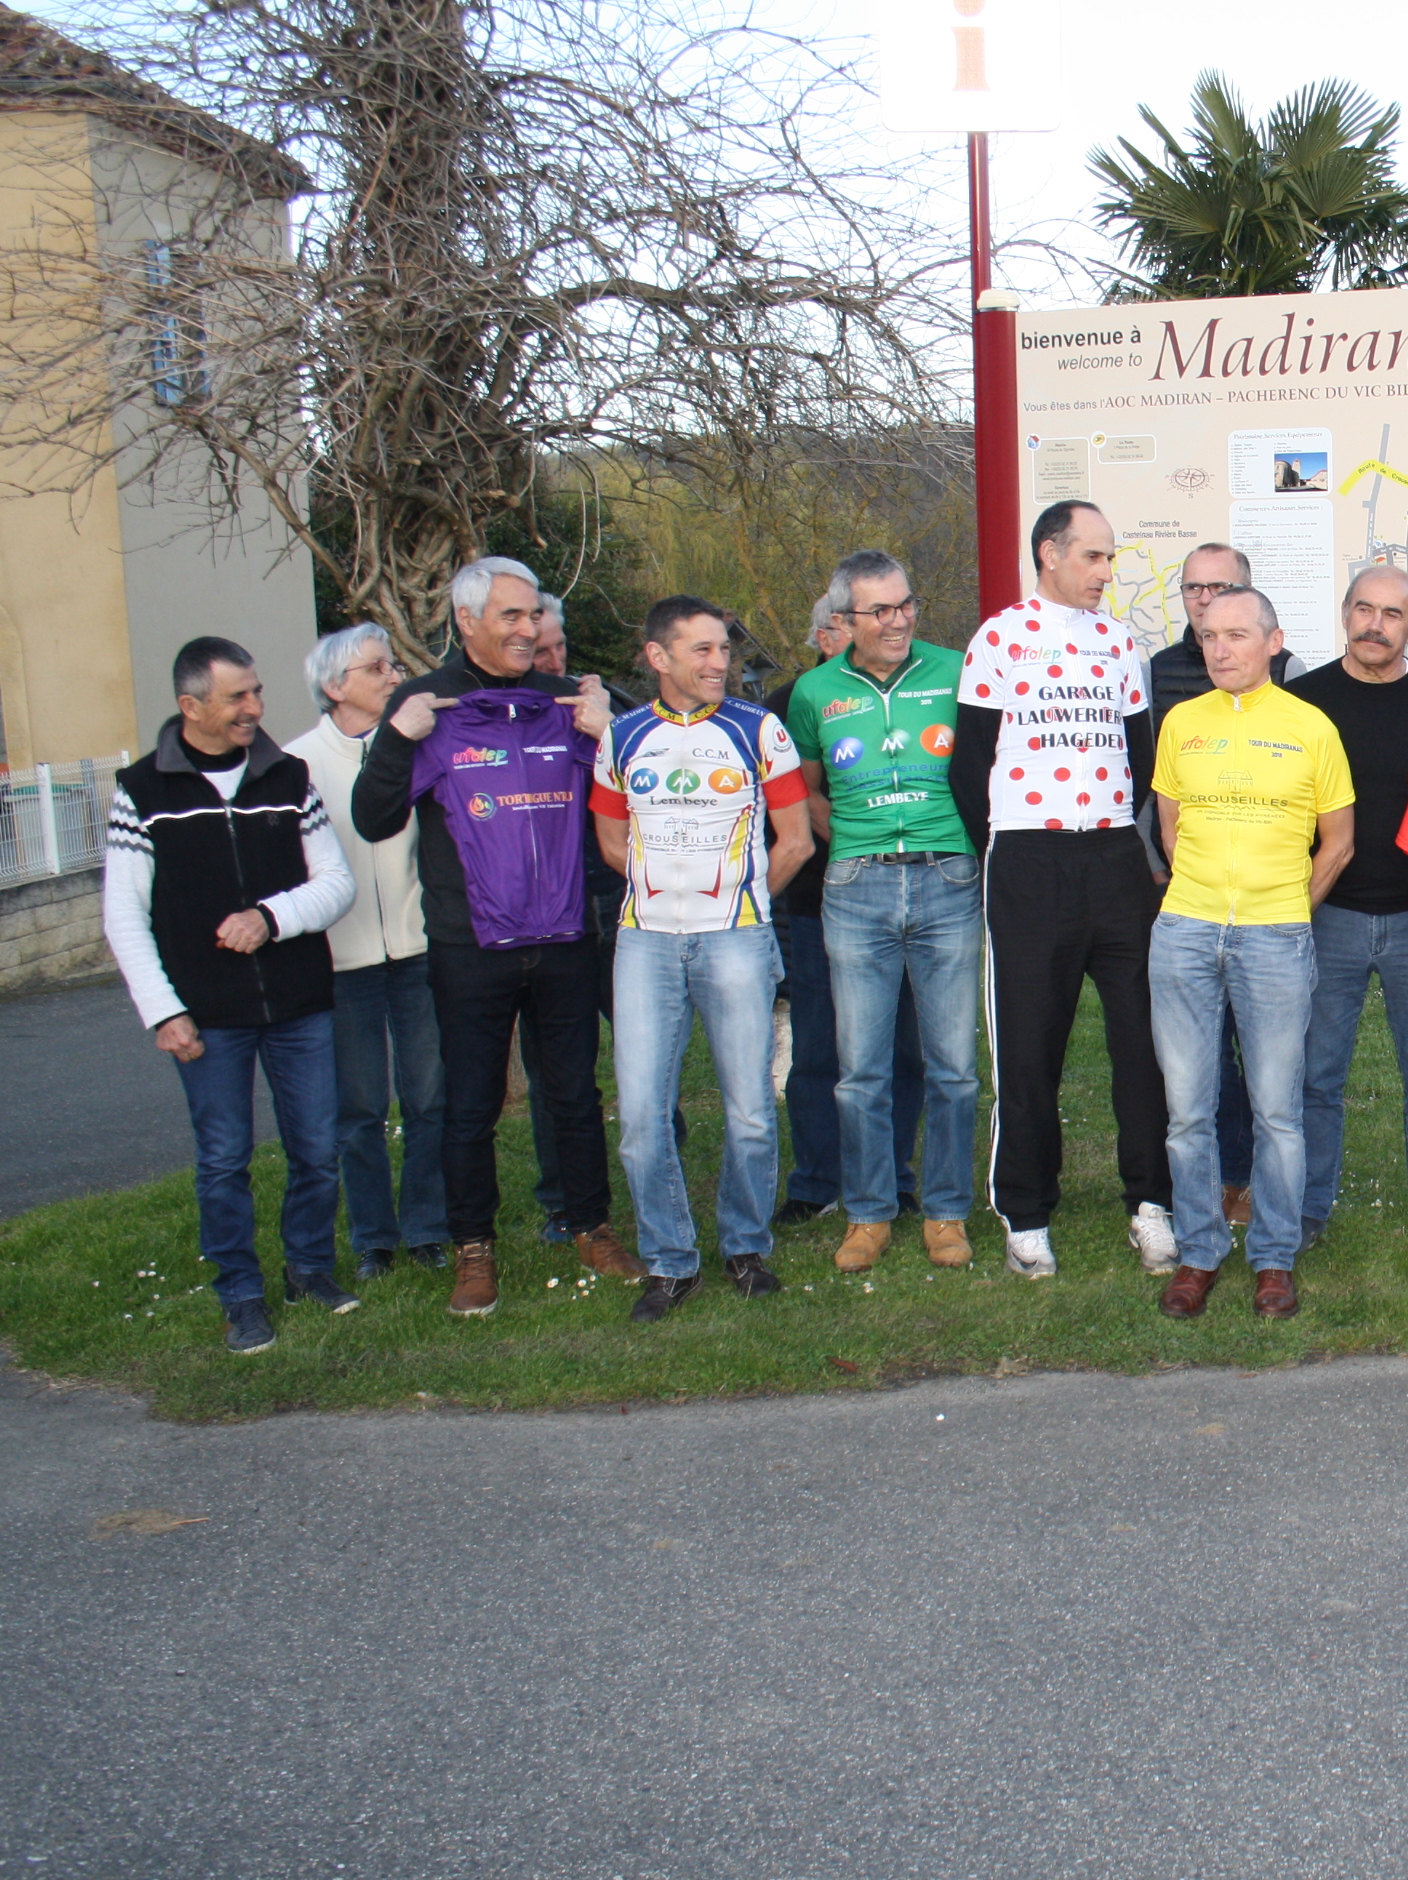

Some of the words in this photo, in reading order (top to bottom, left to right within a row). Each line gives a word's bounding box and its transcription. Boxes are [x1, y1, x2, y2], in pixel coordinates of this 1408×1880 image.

[1021, 329, 1123, 350] bienvenue
[1130, 325, 1142, 344] à
[1057, 354, 1124, 371] welcome
[1128, 352, 1143, 368] to
[1023, 401, 1048, 412] Vous
[1050, 400, 1071, 411] êtes
[1073, 399, 1098, 410] dans
[1140, 392, 1212, 407] MADIRAN
[1227, 387, 1320, 403] PACHERENC
[1325, 386, 1349, 399] DU
[1353, 384, 1381, 398] VIC
[1138, 520, 1170, 528] Commune
[1172, 519, 1181, 528] de
[1038, 686, 1116, 701] GARAGE
[822, 695, 874, 718] ufolep
[1041, 732, 1122, 749] HAGEDET
[1180, 735, 1229, 755] ufolep
[692, 747, 730, 760] C.C.M
[649, 796, 719, 808] Lembeye
[867, 791, 929, 808] LEMBEYE
[1189, 794, 1289, 807] CROUSEILLES
[642, 833, 728, 844] CROUSEILLES
